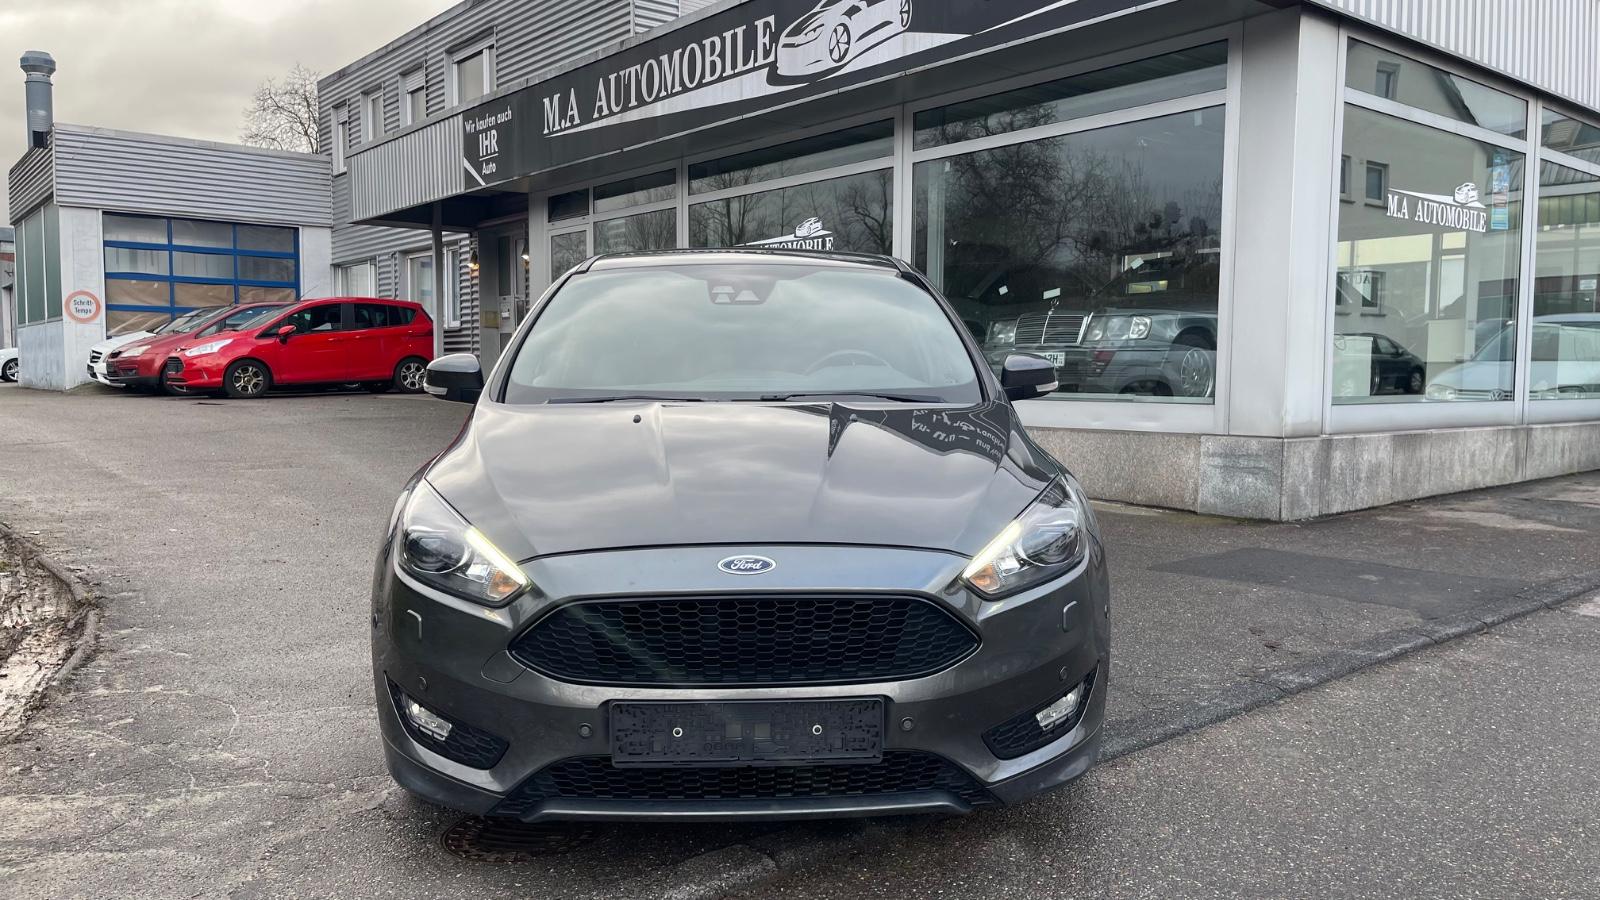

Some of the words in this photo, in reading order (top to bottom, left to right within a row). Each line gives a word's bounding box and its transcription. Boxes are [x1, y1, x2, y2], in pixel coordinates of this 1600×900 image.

[543, 87, 580, 134] M.A
[593, 15, 776, 118] AUTOMOBILE
[464, 119, 475, 134] Wir
[475, 113, 496, 131] kaufen
[496, 105, 512, 124] auch
[479, 129, 498, 156] IHR
[481, 161, 497, 176] Auto
[1386, 193, 1409, 219] M.A
[1414, 199, 1487, 232] AUTOMOBILE
[762, 237, 834, 251] MOBILE
[731, 559, 762, 570] Ford
